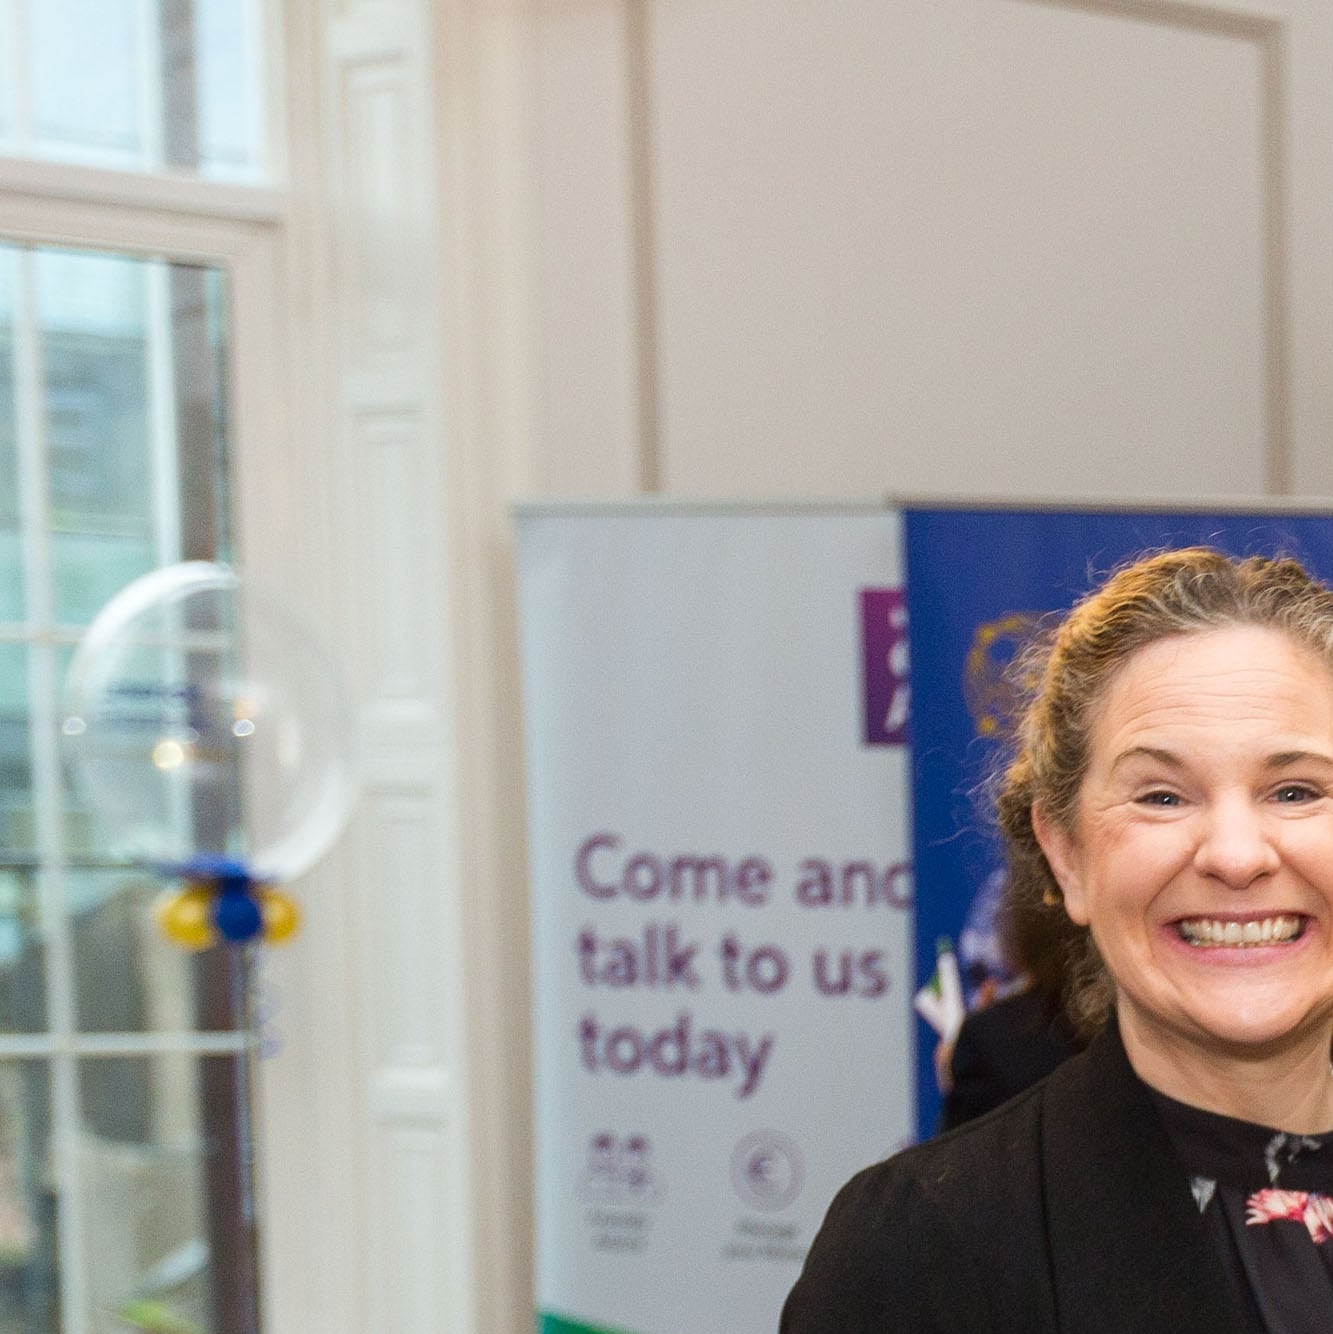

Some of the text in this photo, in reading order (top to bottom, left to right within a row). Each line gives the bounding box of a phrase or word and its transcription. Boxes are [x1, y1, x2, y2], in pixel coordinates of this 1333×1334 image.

[573, 832, 773, 906] Come
[577, 922, 890, 999] talk to us
[577, 1008, 775, 1100] today
